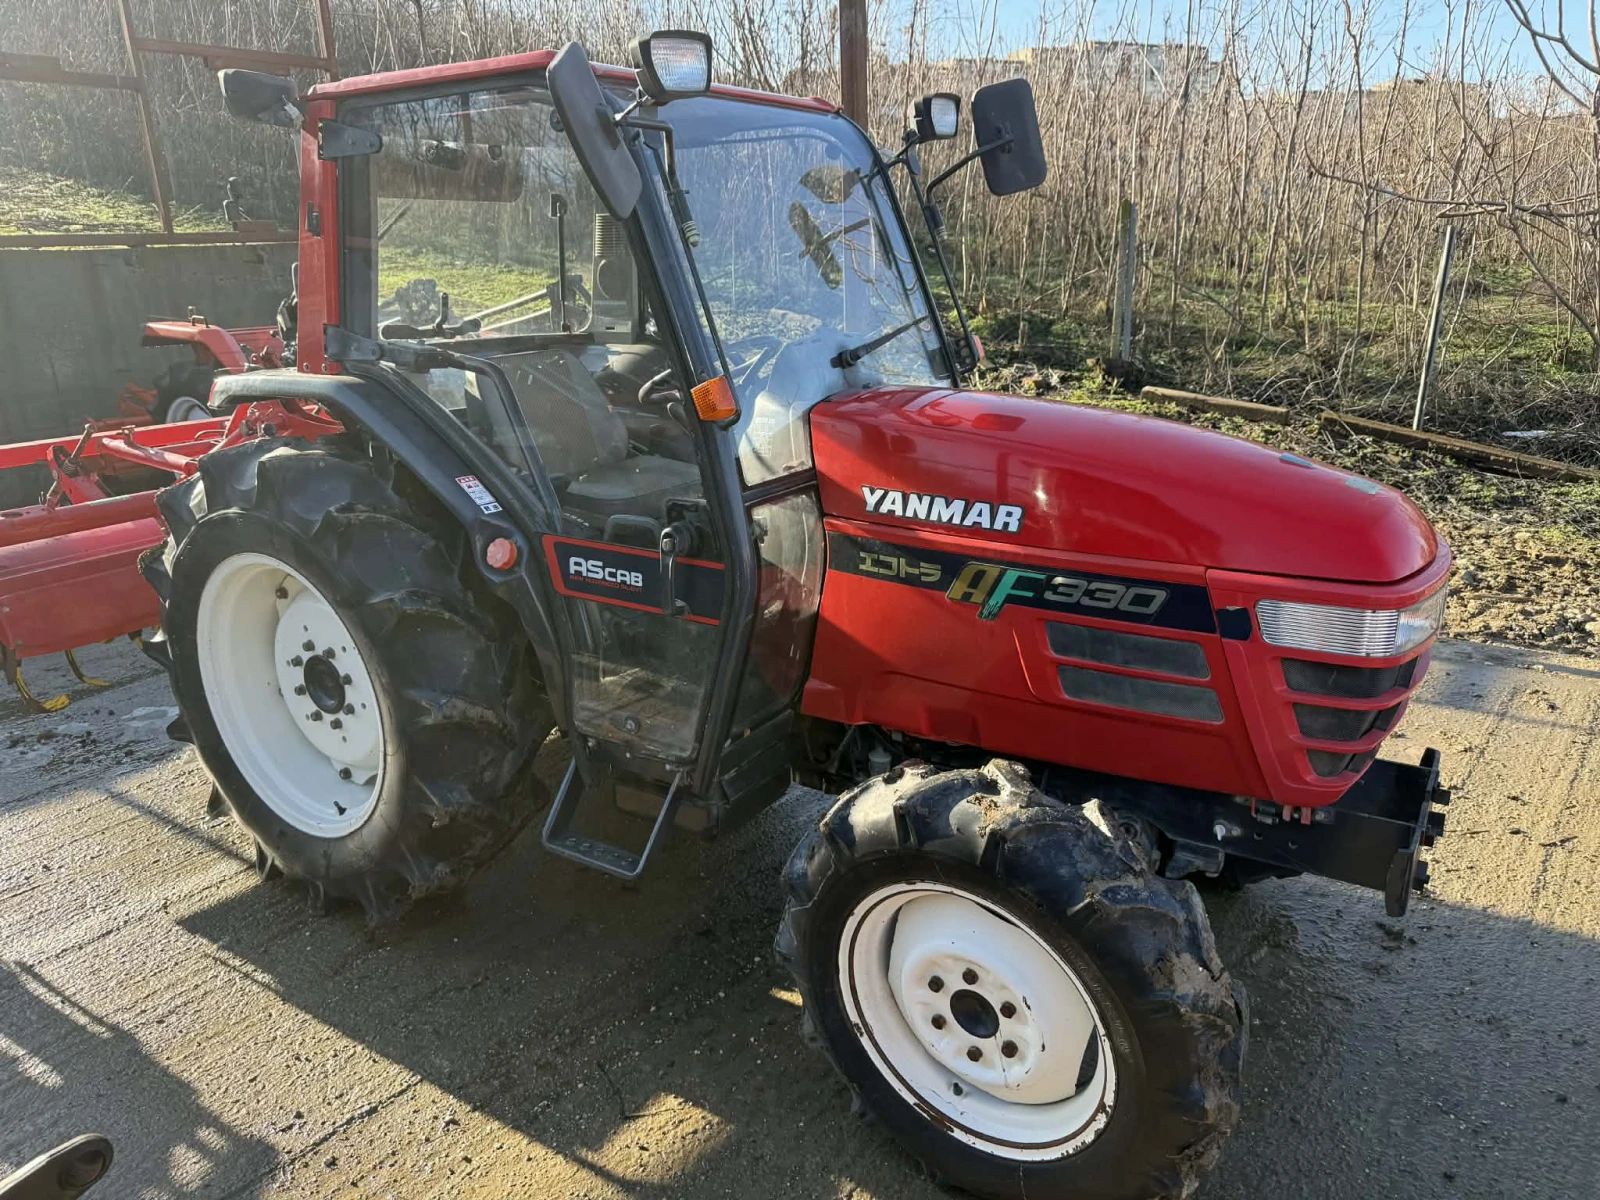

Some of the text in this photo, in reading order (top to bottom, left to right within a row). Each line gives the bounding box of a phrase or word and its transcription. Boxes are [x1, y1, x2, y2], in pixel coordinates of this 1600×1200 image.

[862, 486, 1024, 532] YANMAR
[859, 551, 941, 582] エコトラ
